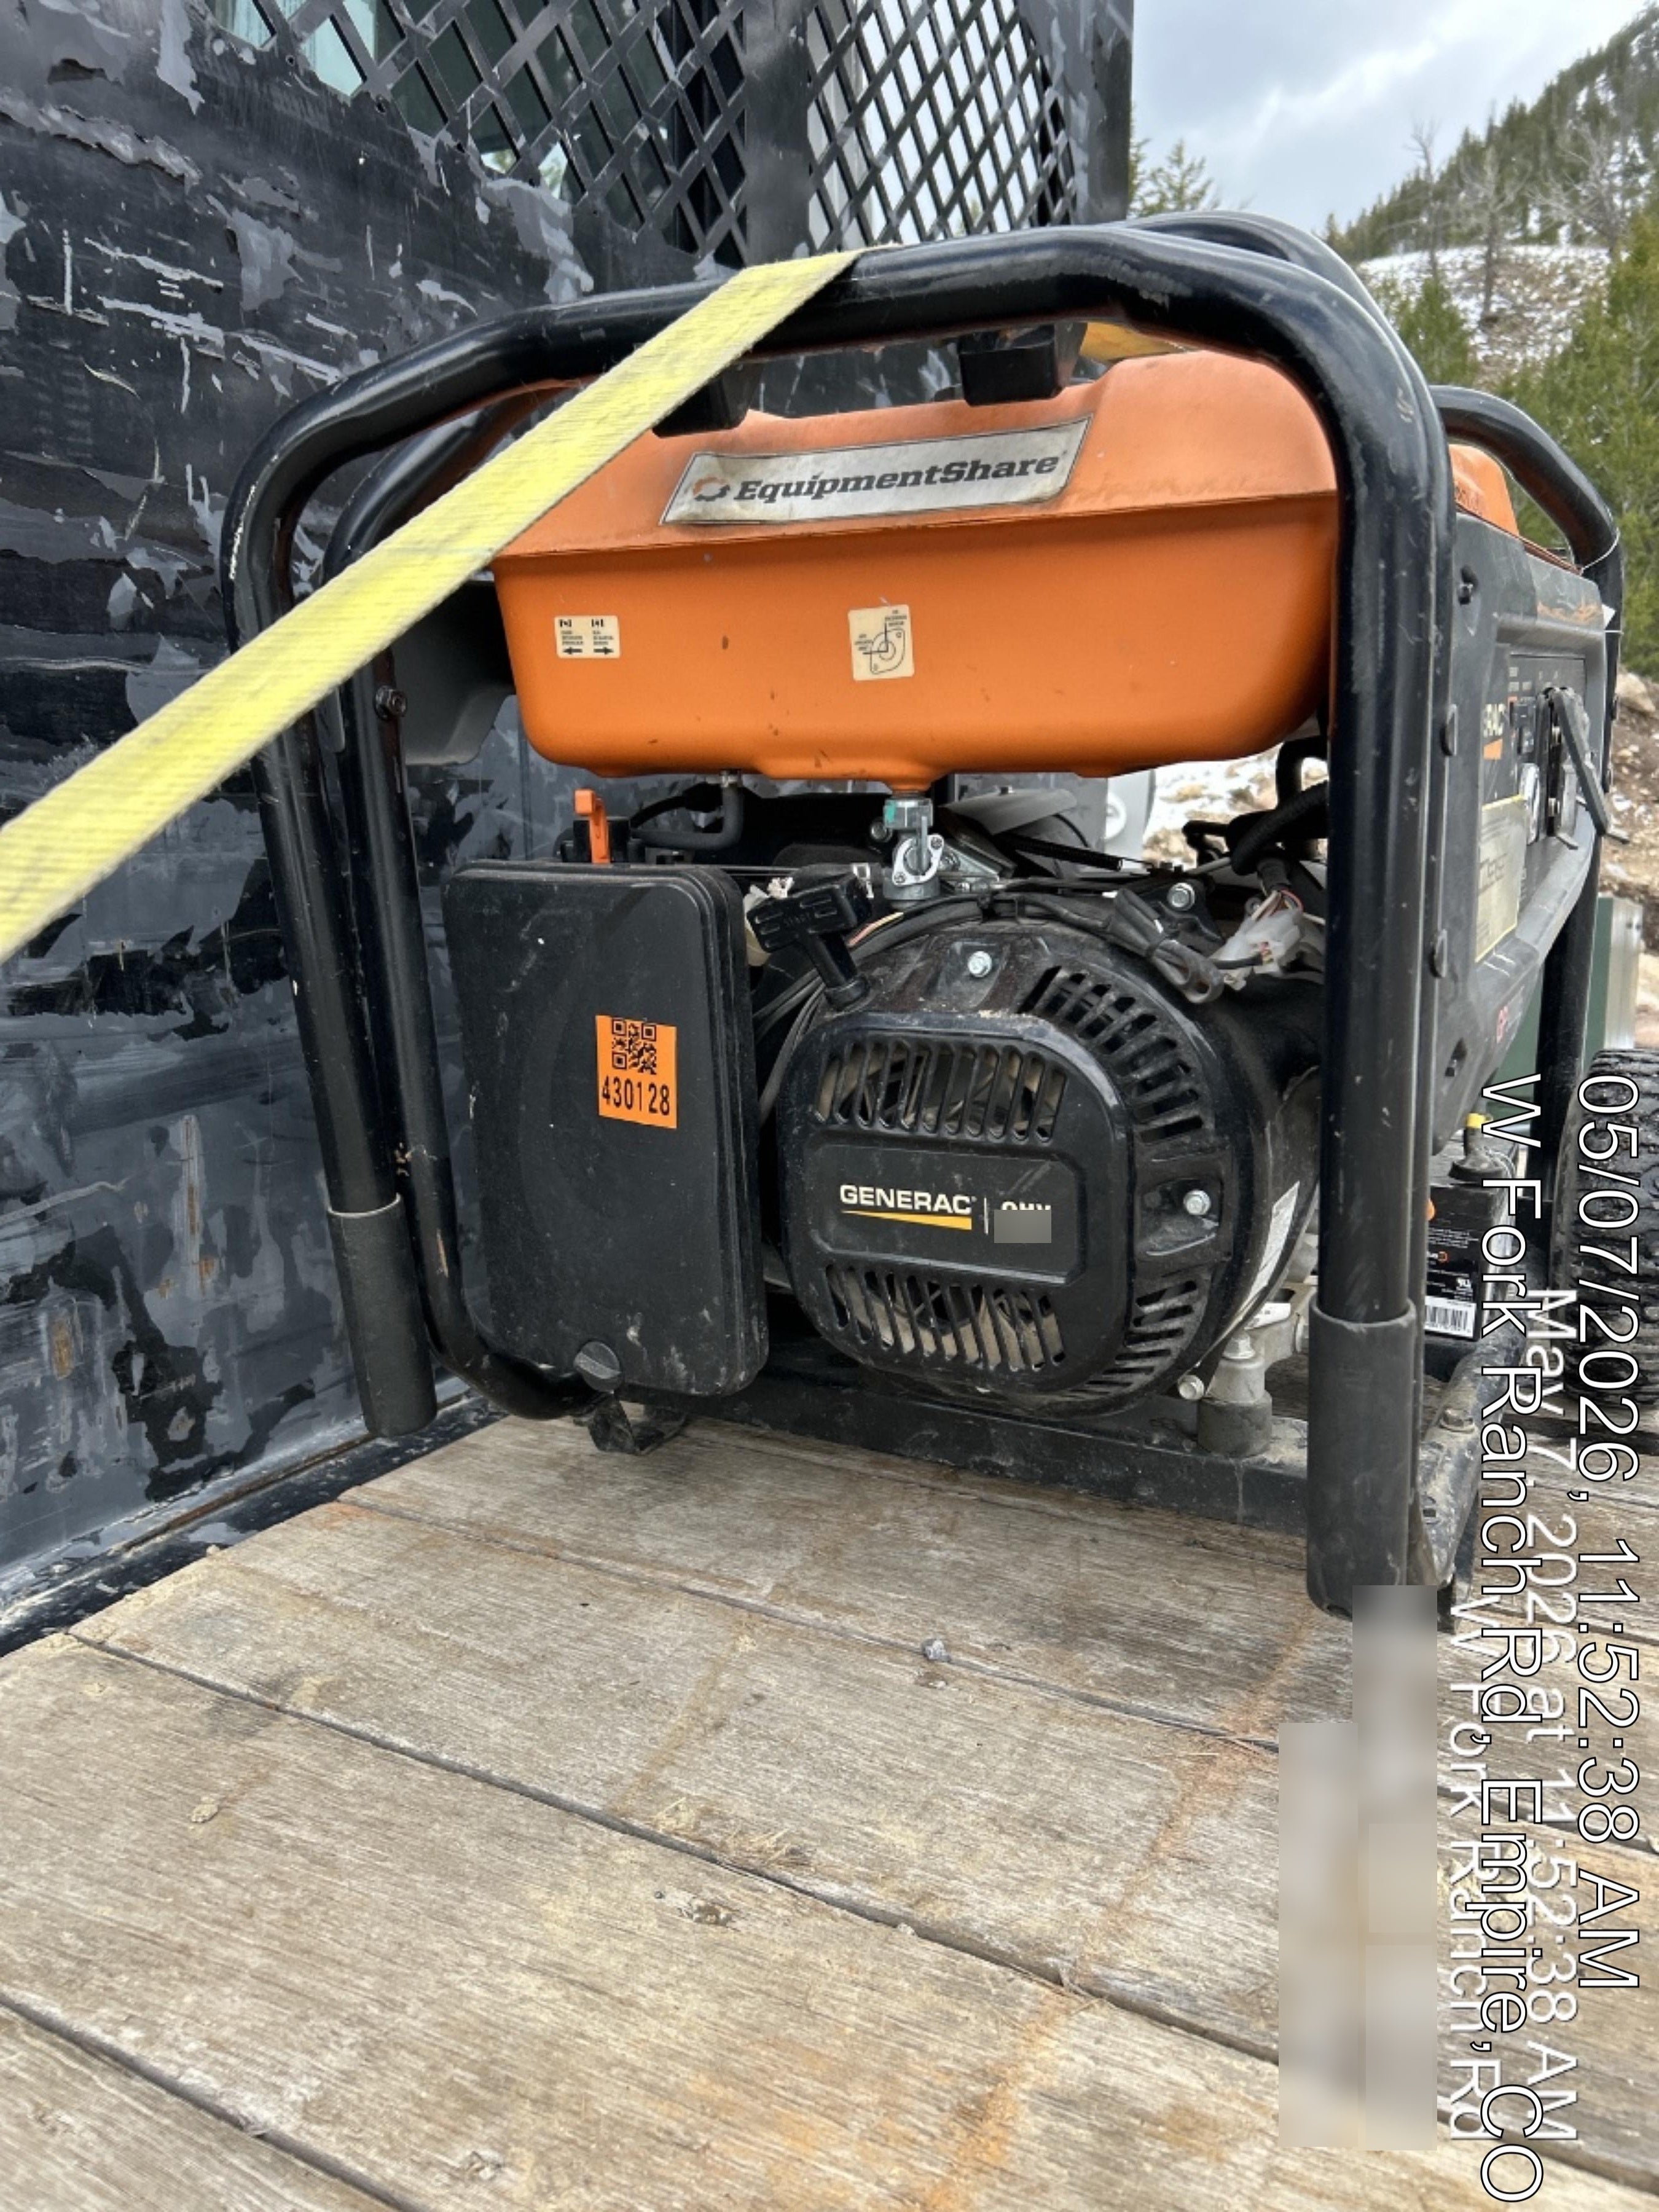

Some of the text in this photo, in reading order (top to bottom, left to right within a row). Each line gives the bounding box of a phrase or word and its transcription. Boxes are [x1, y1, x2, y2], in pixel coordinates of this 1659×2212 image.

[734, 455, 1058, 504] EquipmentShare
[602, 1075, 670, 1116] 430128
[839, 1184, 973, 1215] GENERAC
